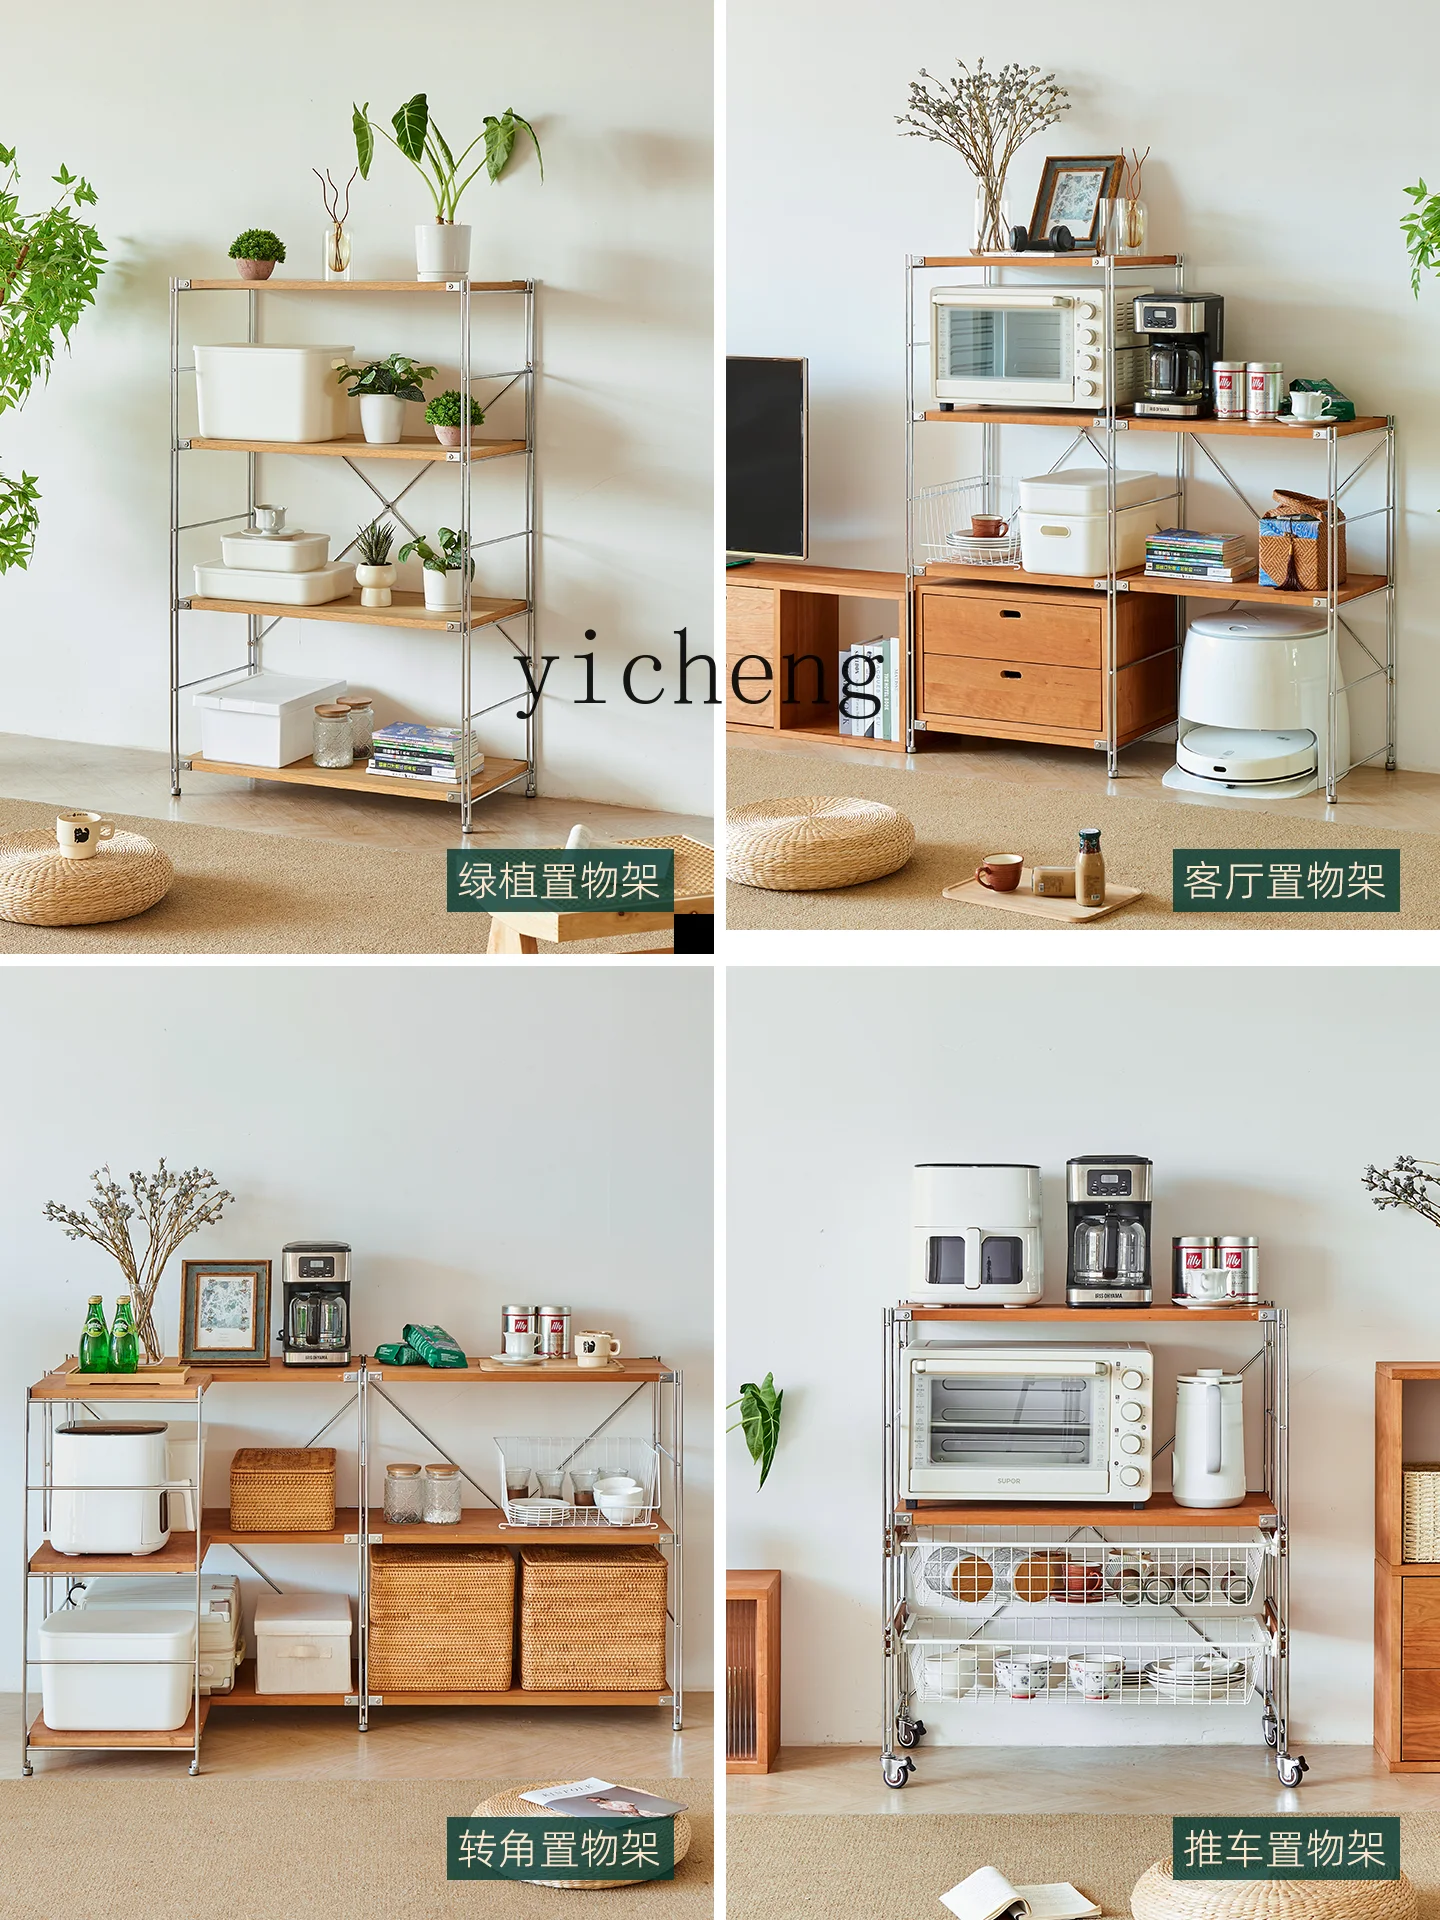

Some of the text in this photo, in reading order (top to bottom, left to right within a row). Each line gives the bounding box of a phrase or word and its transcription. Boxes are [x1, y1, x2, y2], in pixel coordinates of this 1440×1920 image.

[1219, 377, 1231, 389] illy
[1252, 378, 1263, 390] illy
[1187, 1255, 1202, 1268] illy
[1226, 1254, 1241, 1268] illy
[515, 1321, 527, 1332] illy
[551, 1321, 563, 1332] illy
[997, 1477, 1021, 1485] SUPOR
